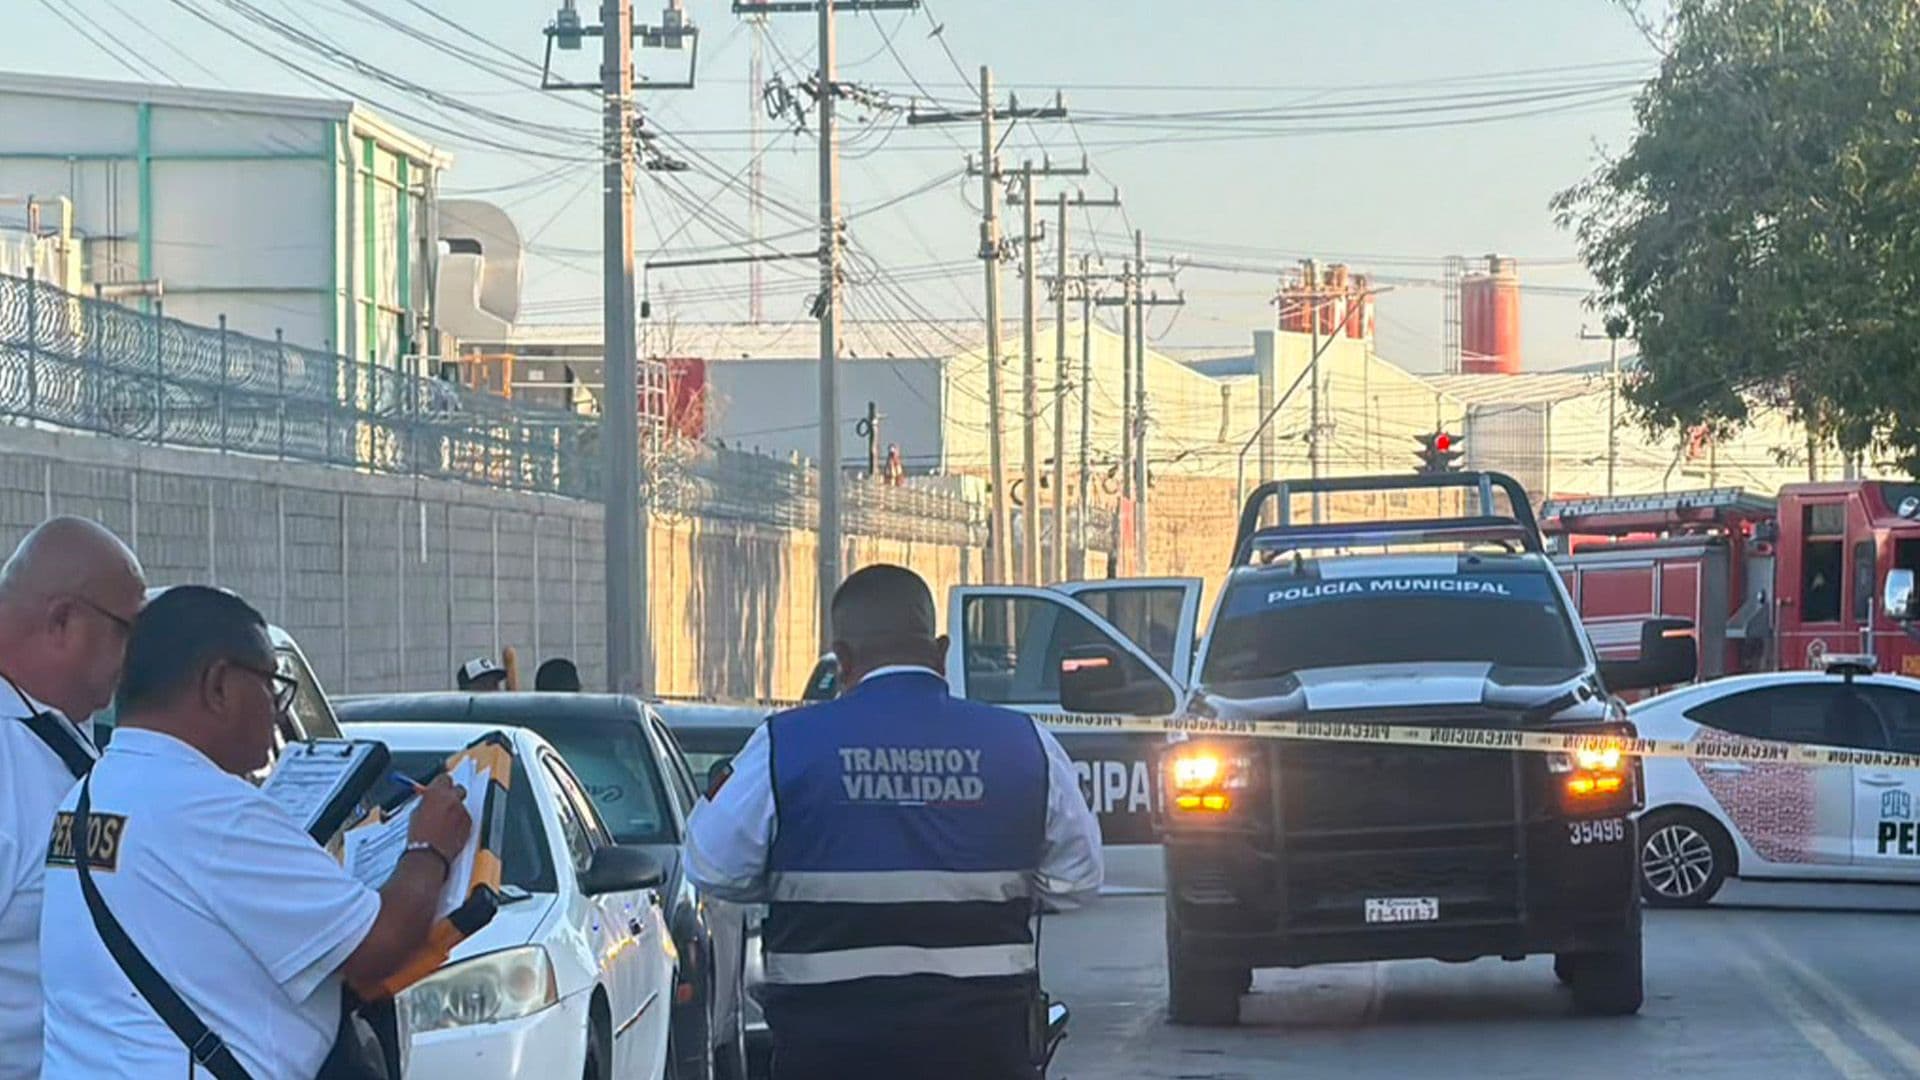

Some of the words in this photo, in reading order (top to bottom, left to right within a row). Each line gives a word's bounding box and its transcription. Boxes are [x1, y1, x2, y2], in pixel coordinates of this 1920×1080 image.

[1267, 580, 1363, 603] POLICÍA
[1370, 579, 1511, 596] MUNICIPAL
[838, 747, 964, 773] TRANSITO
[965, 748, 982, 773] Y
[842, 774, 984, 801] VIALIDAD
[1568, 818, 1624, 845] 35496
